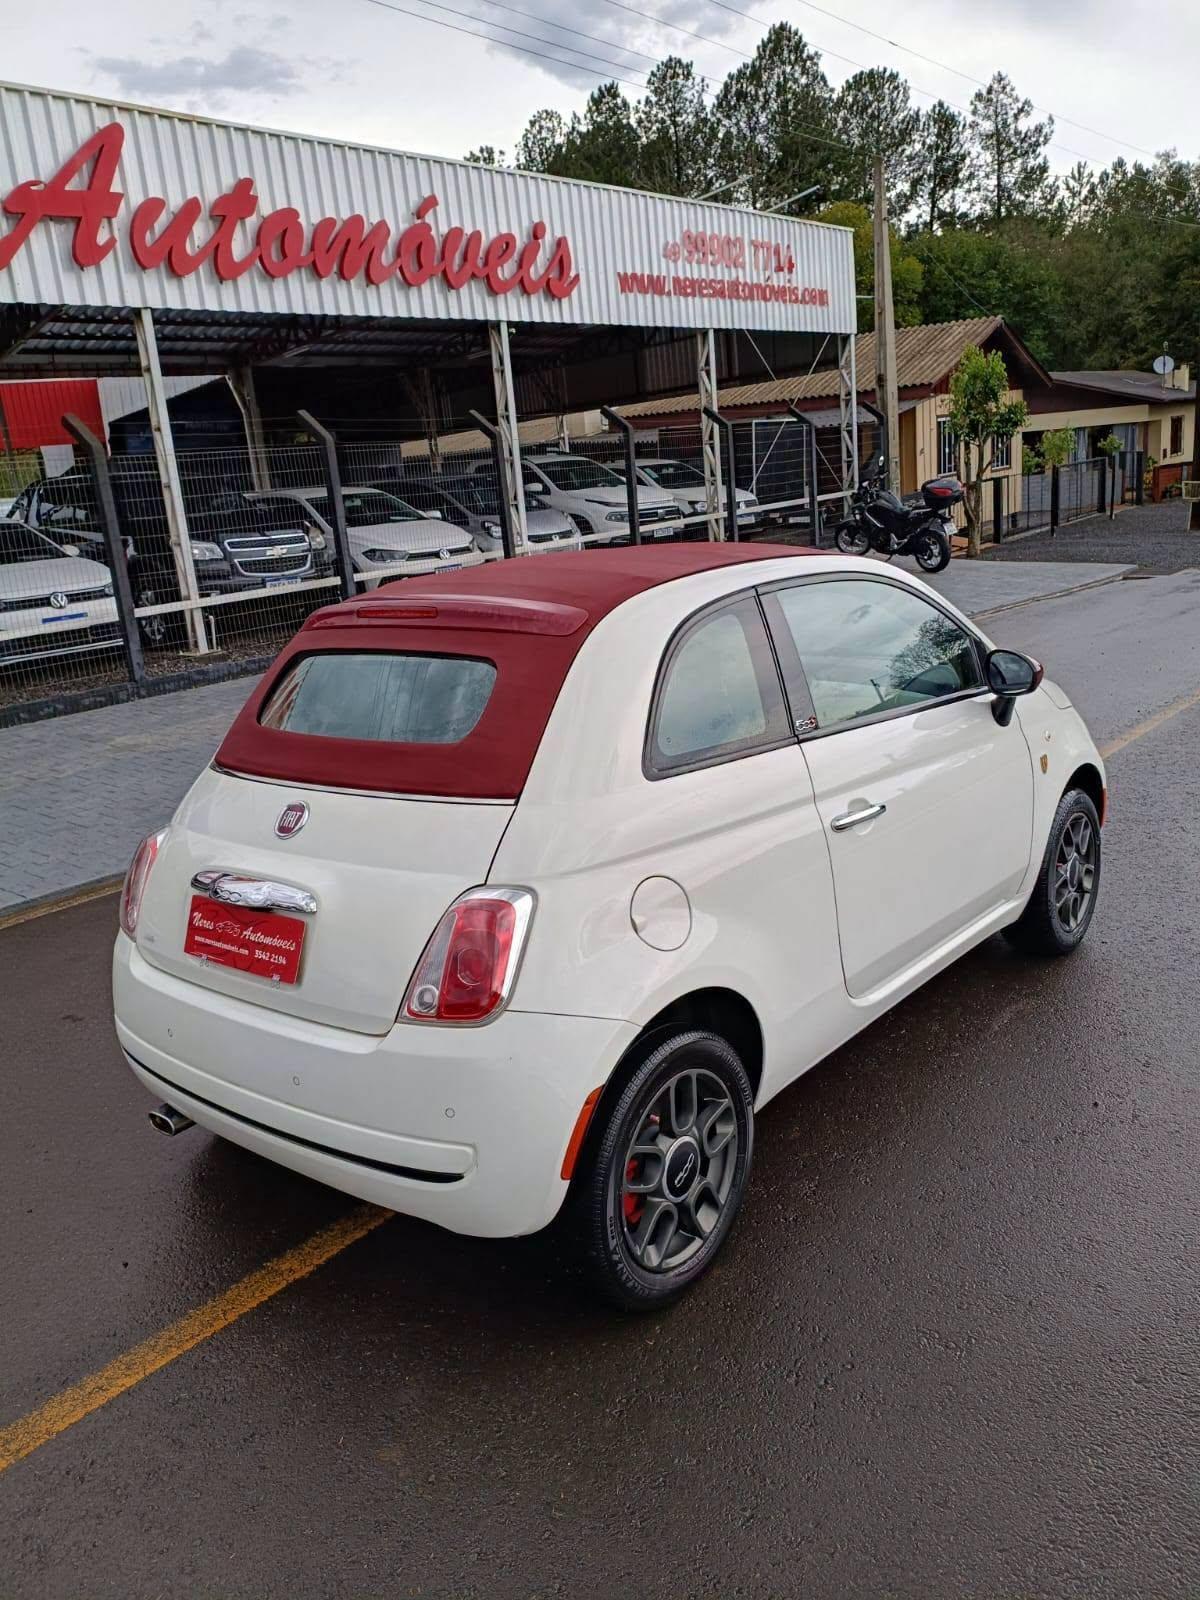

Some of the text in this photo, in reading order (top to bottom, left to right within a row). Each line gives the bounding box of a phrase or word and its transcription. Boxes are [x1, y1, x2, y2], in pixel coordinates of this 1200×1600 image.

[0, 122, 580, 299] Automóveis
[281, 811, 302, 828] FIAT
[192, 911, 296, 951] Neres Automóveis
